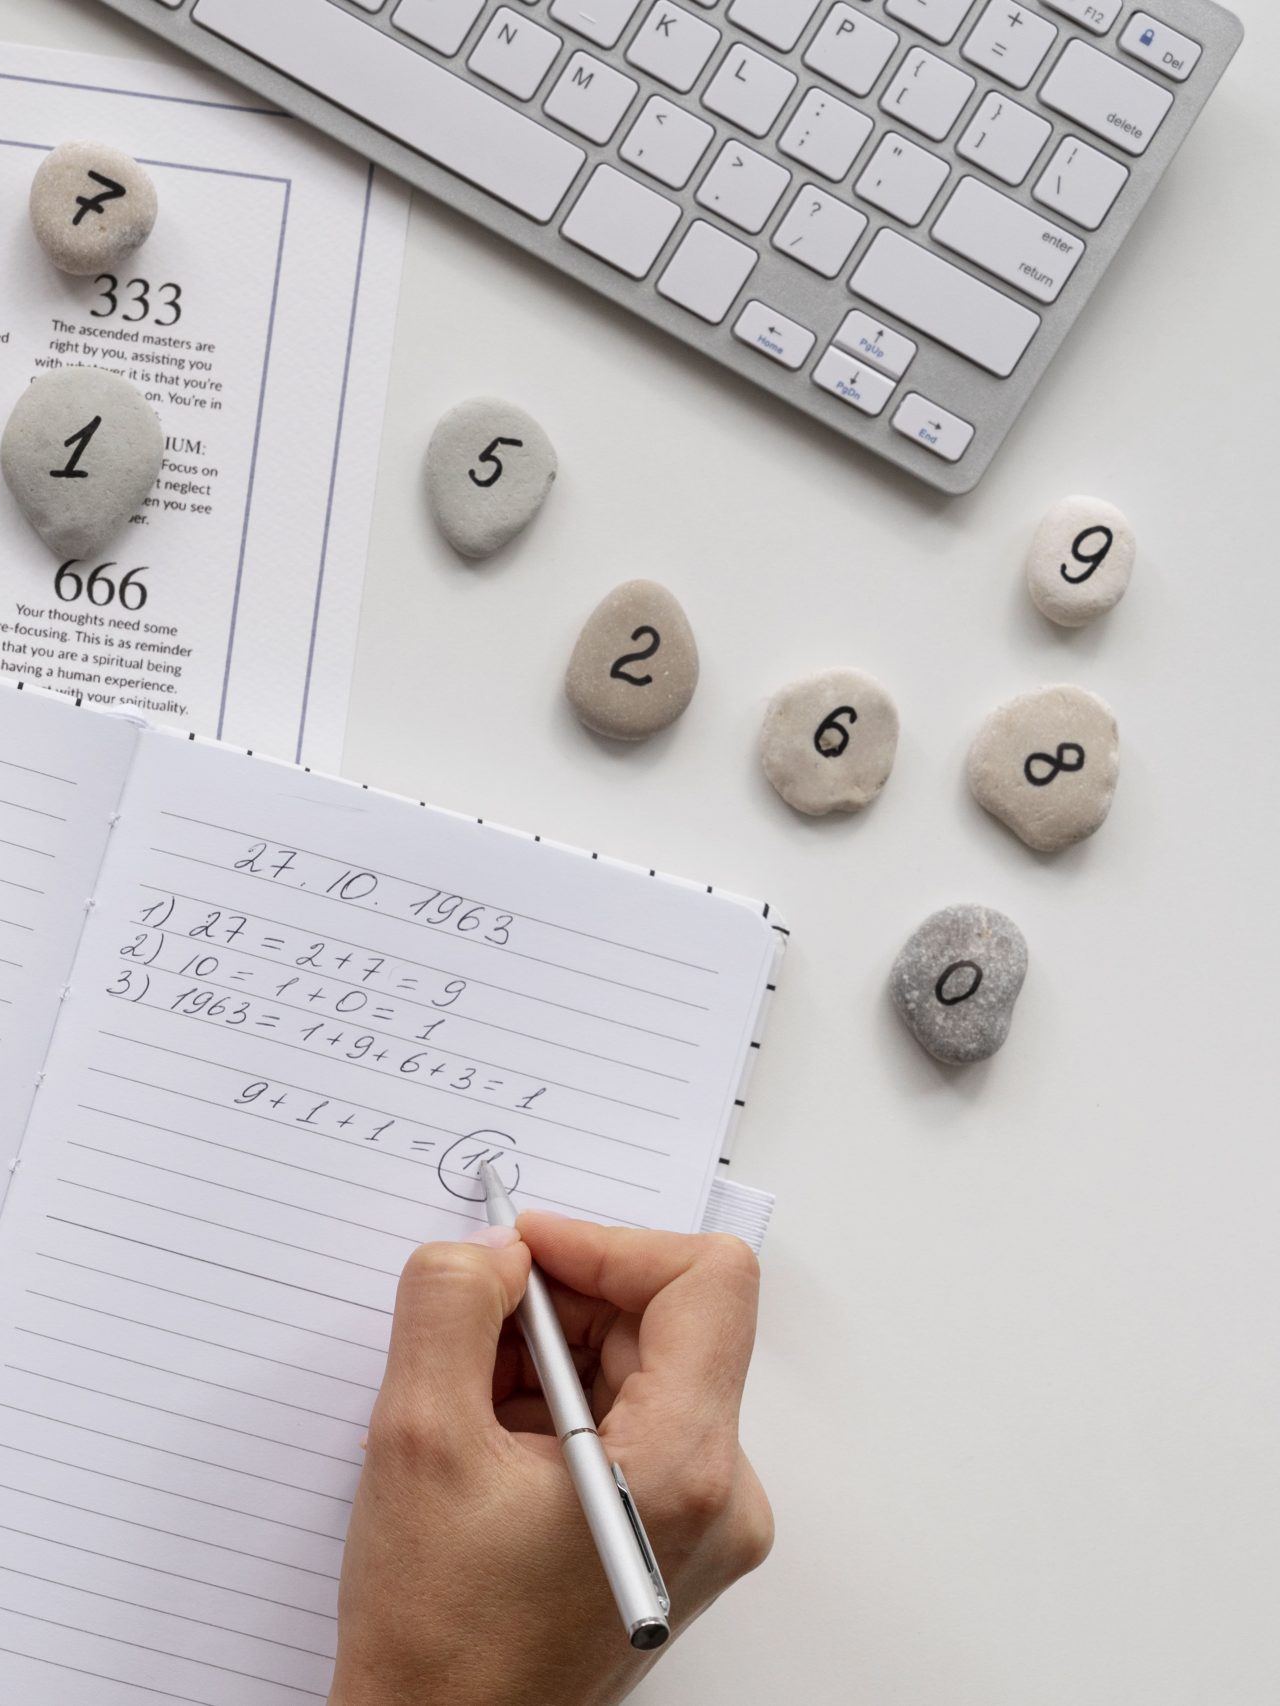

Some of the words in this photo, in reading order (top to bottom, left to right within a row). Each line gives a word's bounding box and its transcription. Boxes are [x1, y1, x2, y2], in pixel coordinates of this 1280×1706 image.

[655, 13, 678, 37] K
[835, 18, 856, 36] P
[1084, 6, 1105, 24] F12
[498, 23, 518, 45] N
[734, 59, 747, 82] L
[1162, 51, 1184, 71] Del
[571, 66, 595, 90] M
[1106, 111, 1143, 140] delete
[72, 170, 127, 226] 7
[1041, 231, 1074, 254] enter
[1019, 262, 1054, 288] return
[90, 273, 182, 326] 333
[52, 319, 76, 334] The
[79, 324, 139, 343] ascended
[142, 334, 192, 350] masters
[756, 334, 784, 355] Home
[131, 352, 186, 370] assisting
[859, 337, 885, 360] PgUp
[35, 356, 63, 369] with
[836, 380, 861, 401] PgDn
[50, 415, 102, 478] 1
[918, 428, 938, 445] End
[161, 459, 198, 475] Focus
[468, 436, 523, 488] 5
[164, 480, 212, 496] neglect
[1060, 525, 1113, 584] 9
[54, 558, 150, 611] 666
[16, 603, 45, 618] Your
[48, 608, 105, 627] thoughts
[108, 617, 140, 631] need
[143, 624, 178, 637] some
[75, 630, 101, 646] This
[135, 641, 194, 657] reminder
[610, 625, 660, 686] 2
[0, 659, 42, 678] having
[57, 666, 101, 683] human
[104, 674, 178, 694] experience.
[93, 654, 143, 671] spiritual
[147, 661, 182, 677] being
[813, 705, 858, 757] 6
[1024, 742, 1085, 786] 8
[409, 891, 514, 945] 1963
[120, 932, 165, 965] 2)
[179, 954, 220, 977] 10
[140, 895, 175, 929] 1)
[189, 911, 247, 944] 27
[431, 979, 467, 1008] 9
[935, 960, 983, 1006] 0
[105, 969, 150, 1002] 3)
[170, 987, 250, 1025] 1963
